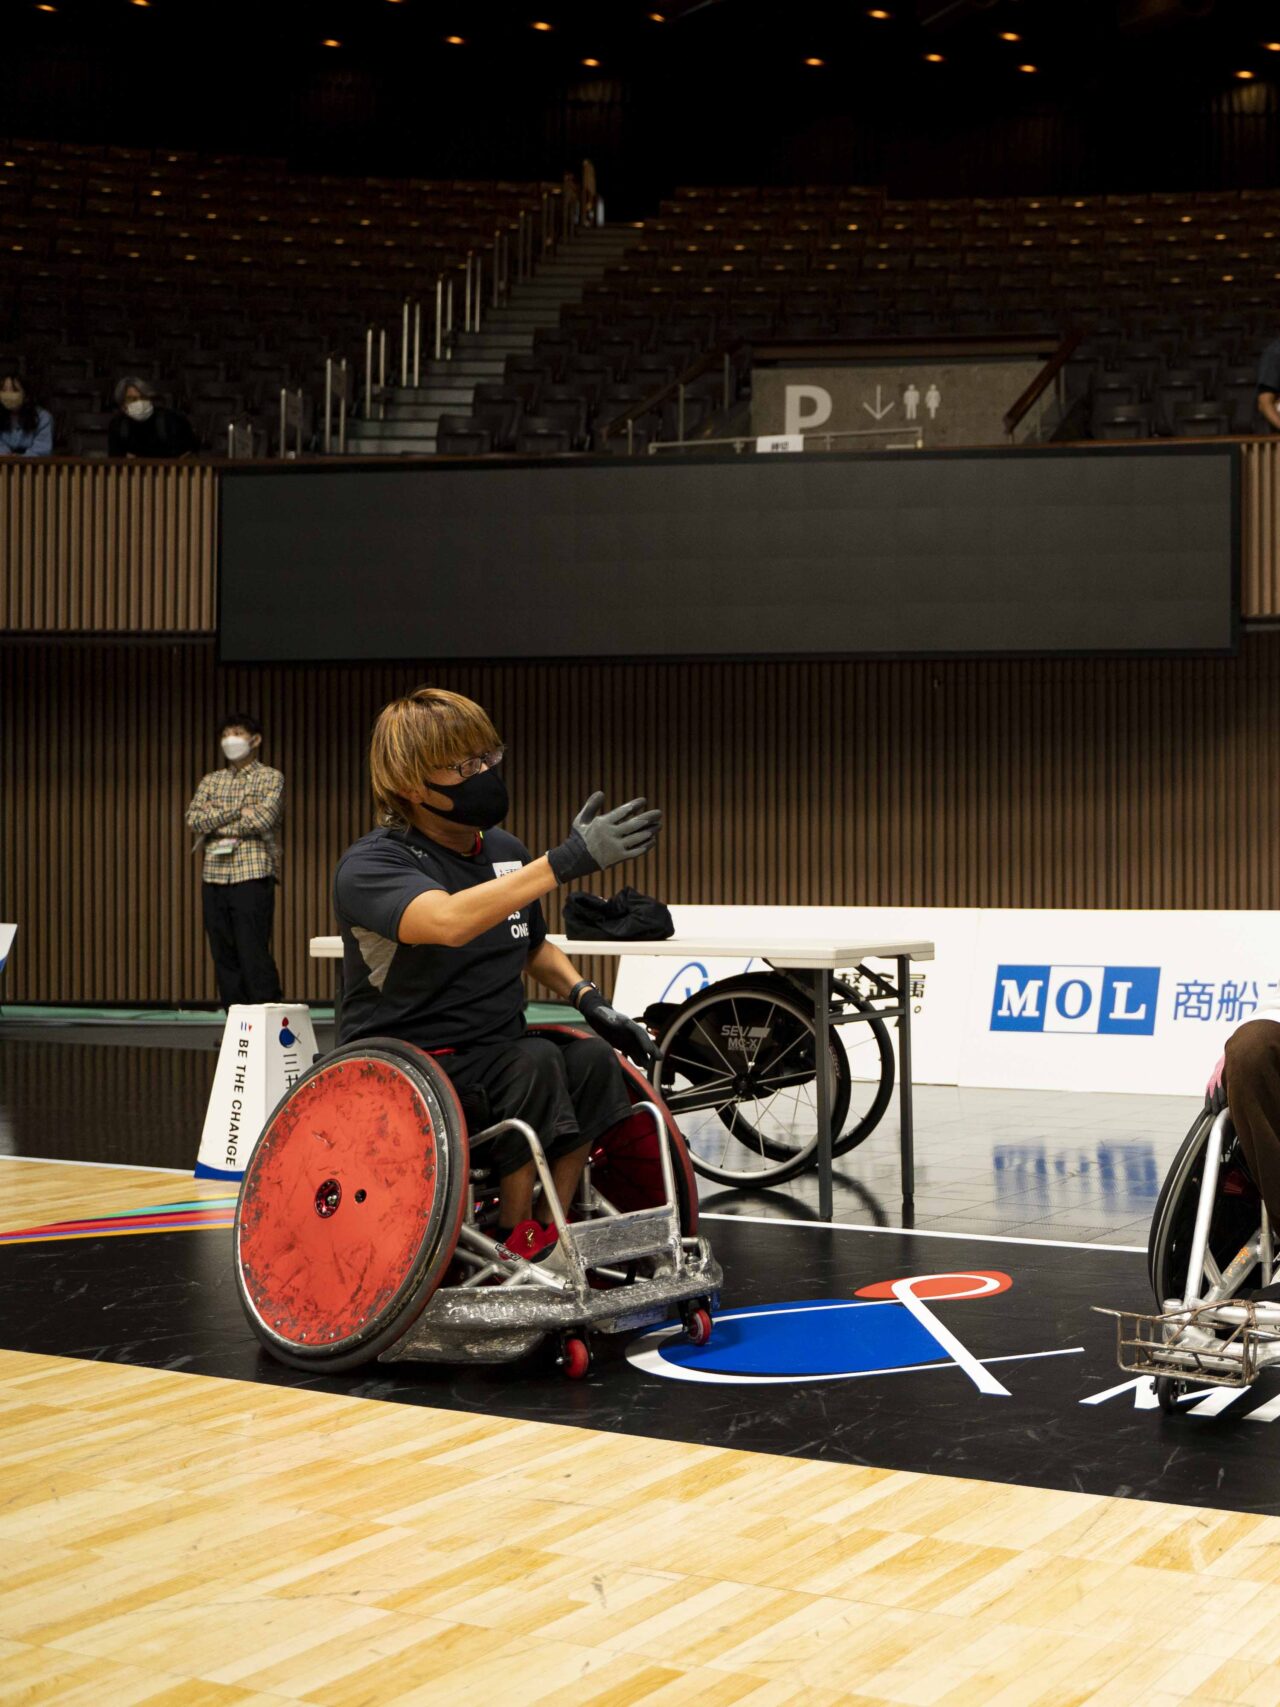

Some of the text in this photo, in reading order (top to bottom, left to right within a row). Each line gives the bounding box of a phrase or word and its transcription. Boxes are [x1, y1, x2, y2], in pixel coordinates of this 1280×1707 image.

[785, 385, 833, 436] P
[996, 978, 1148, 1021] MOL
[1173, 979, 1278, 1022] 商船
[225, 1038, 249, 1167] BE THE CHANGE
